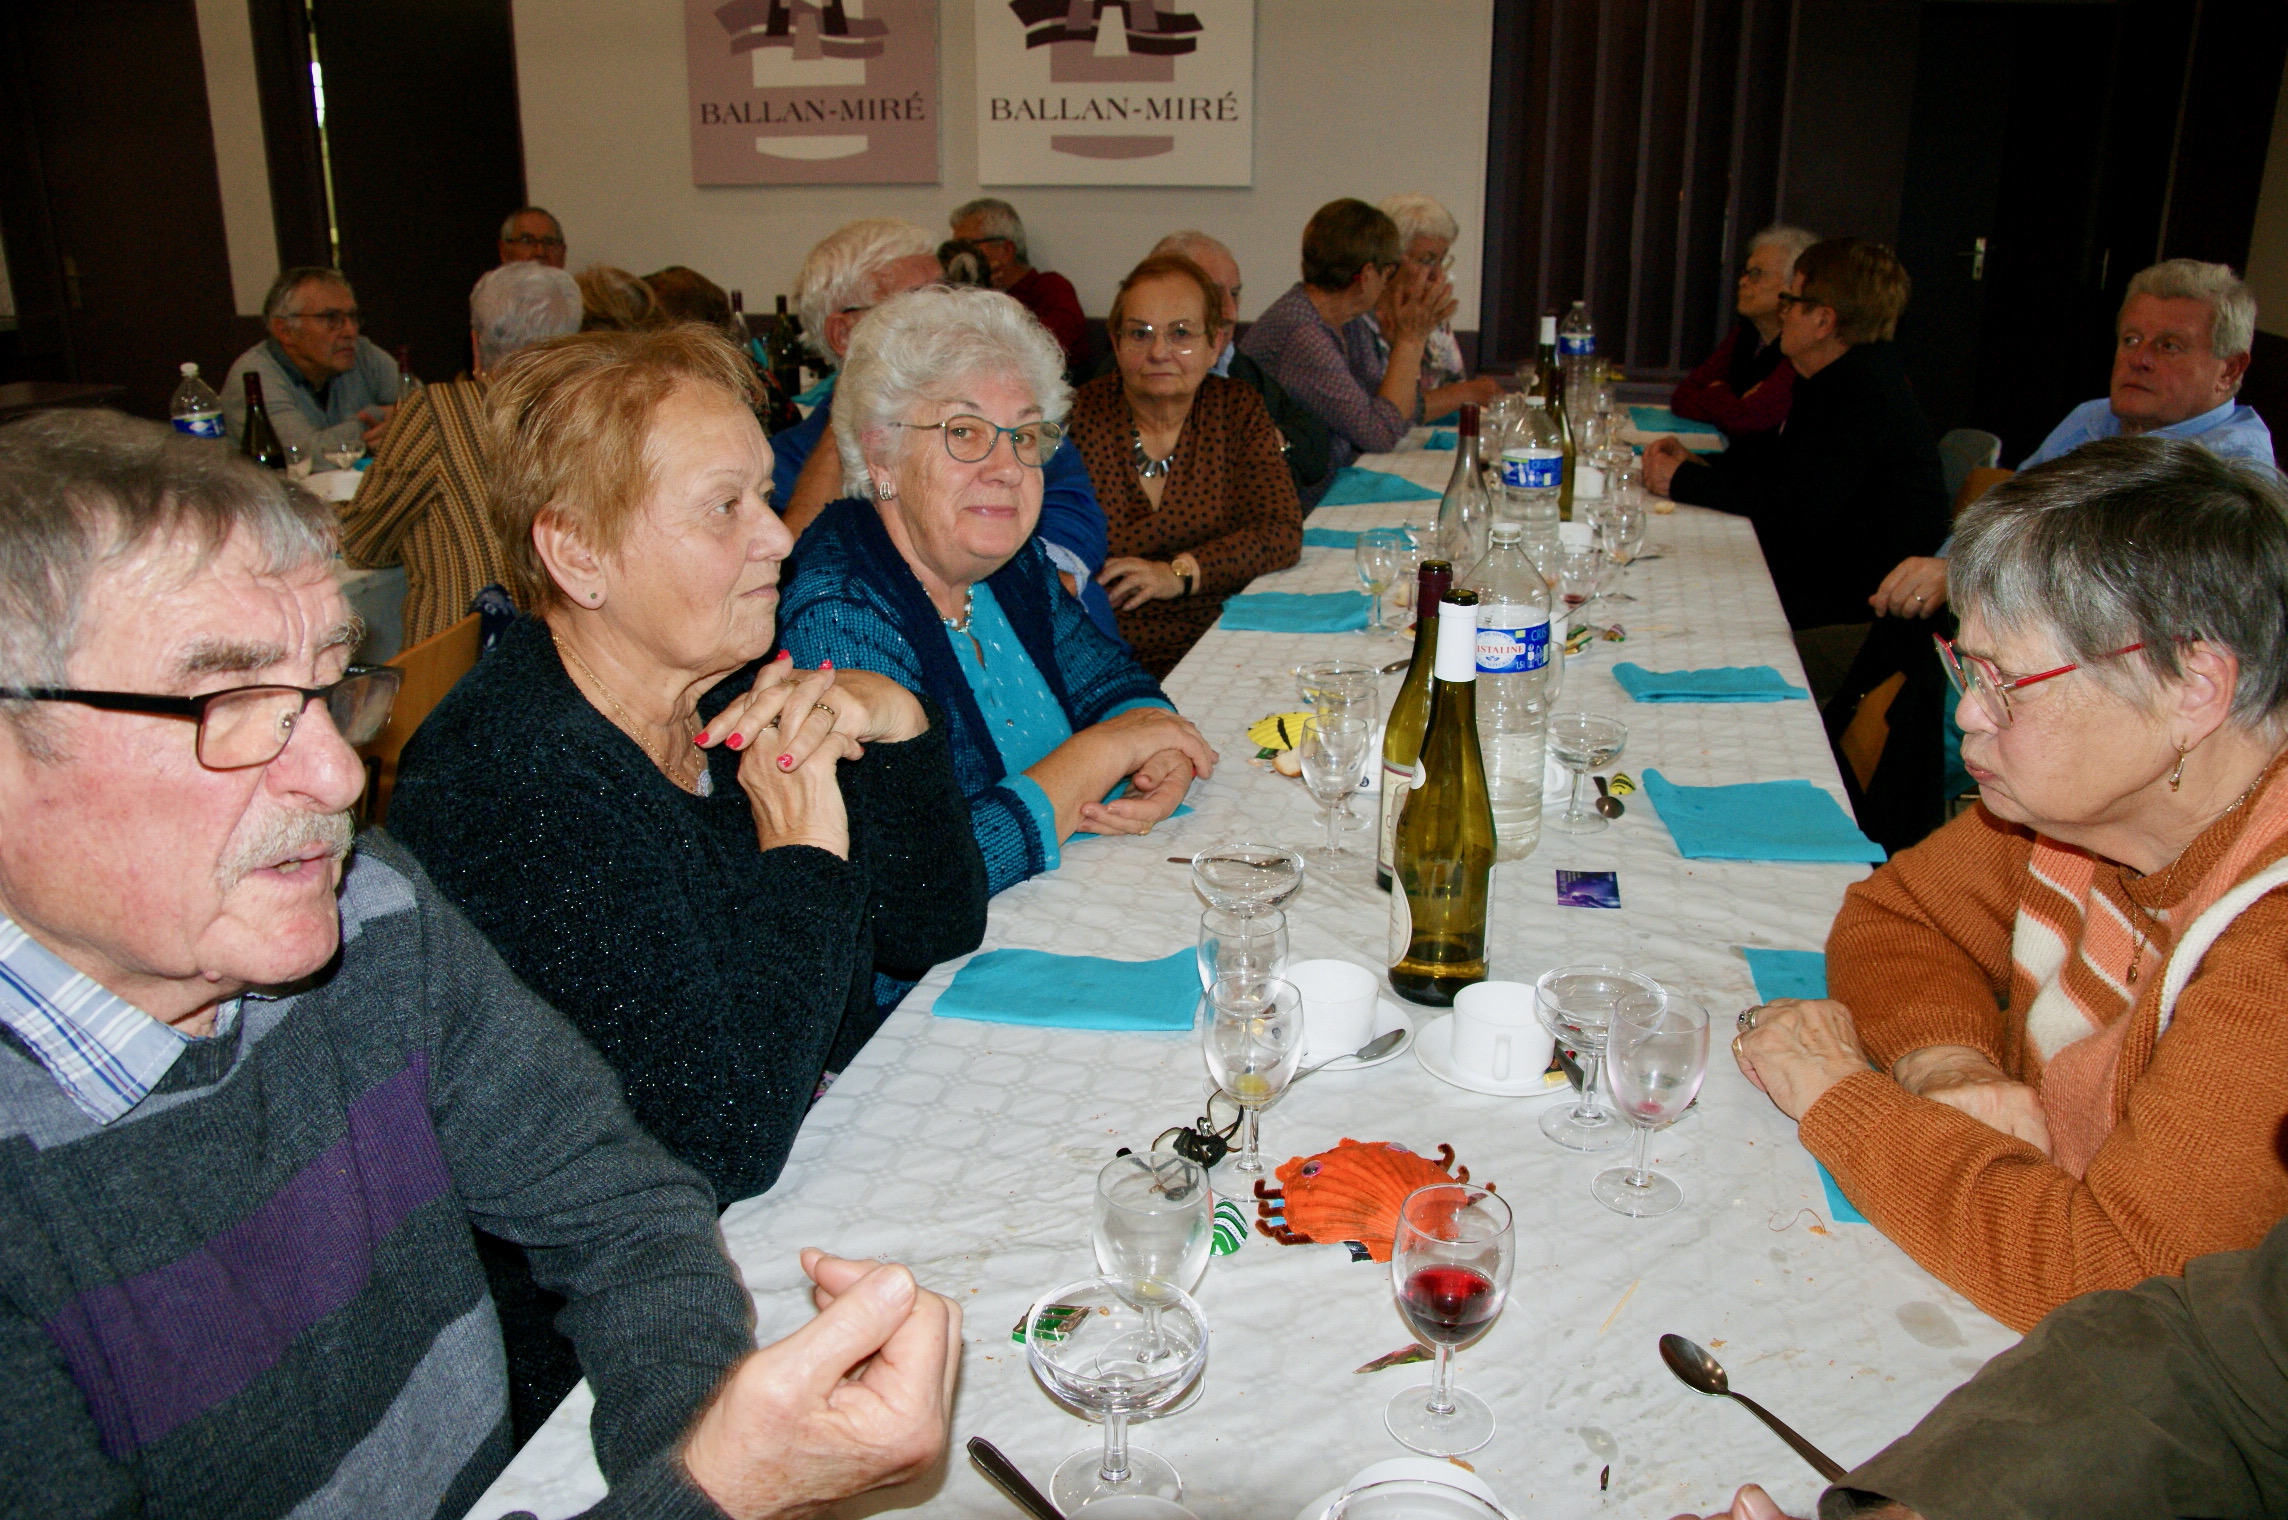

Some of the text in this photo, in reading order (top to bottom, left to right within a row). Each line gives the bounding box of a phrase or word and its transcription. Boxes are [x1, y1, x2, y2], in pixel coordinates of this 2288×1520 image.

[701, 91, 924, 124] BALLAN-MIRÉ
[991, 91, 1239, 120] BALLAN-MIRÉ
[1476, 644, 1523, 653] ISTALINE
